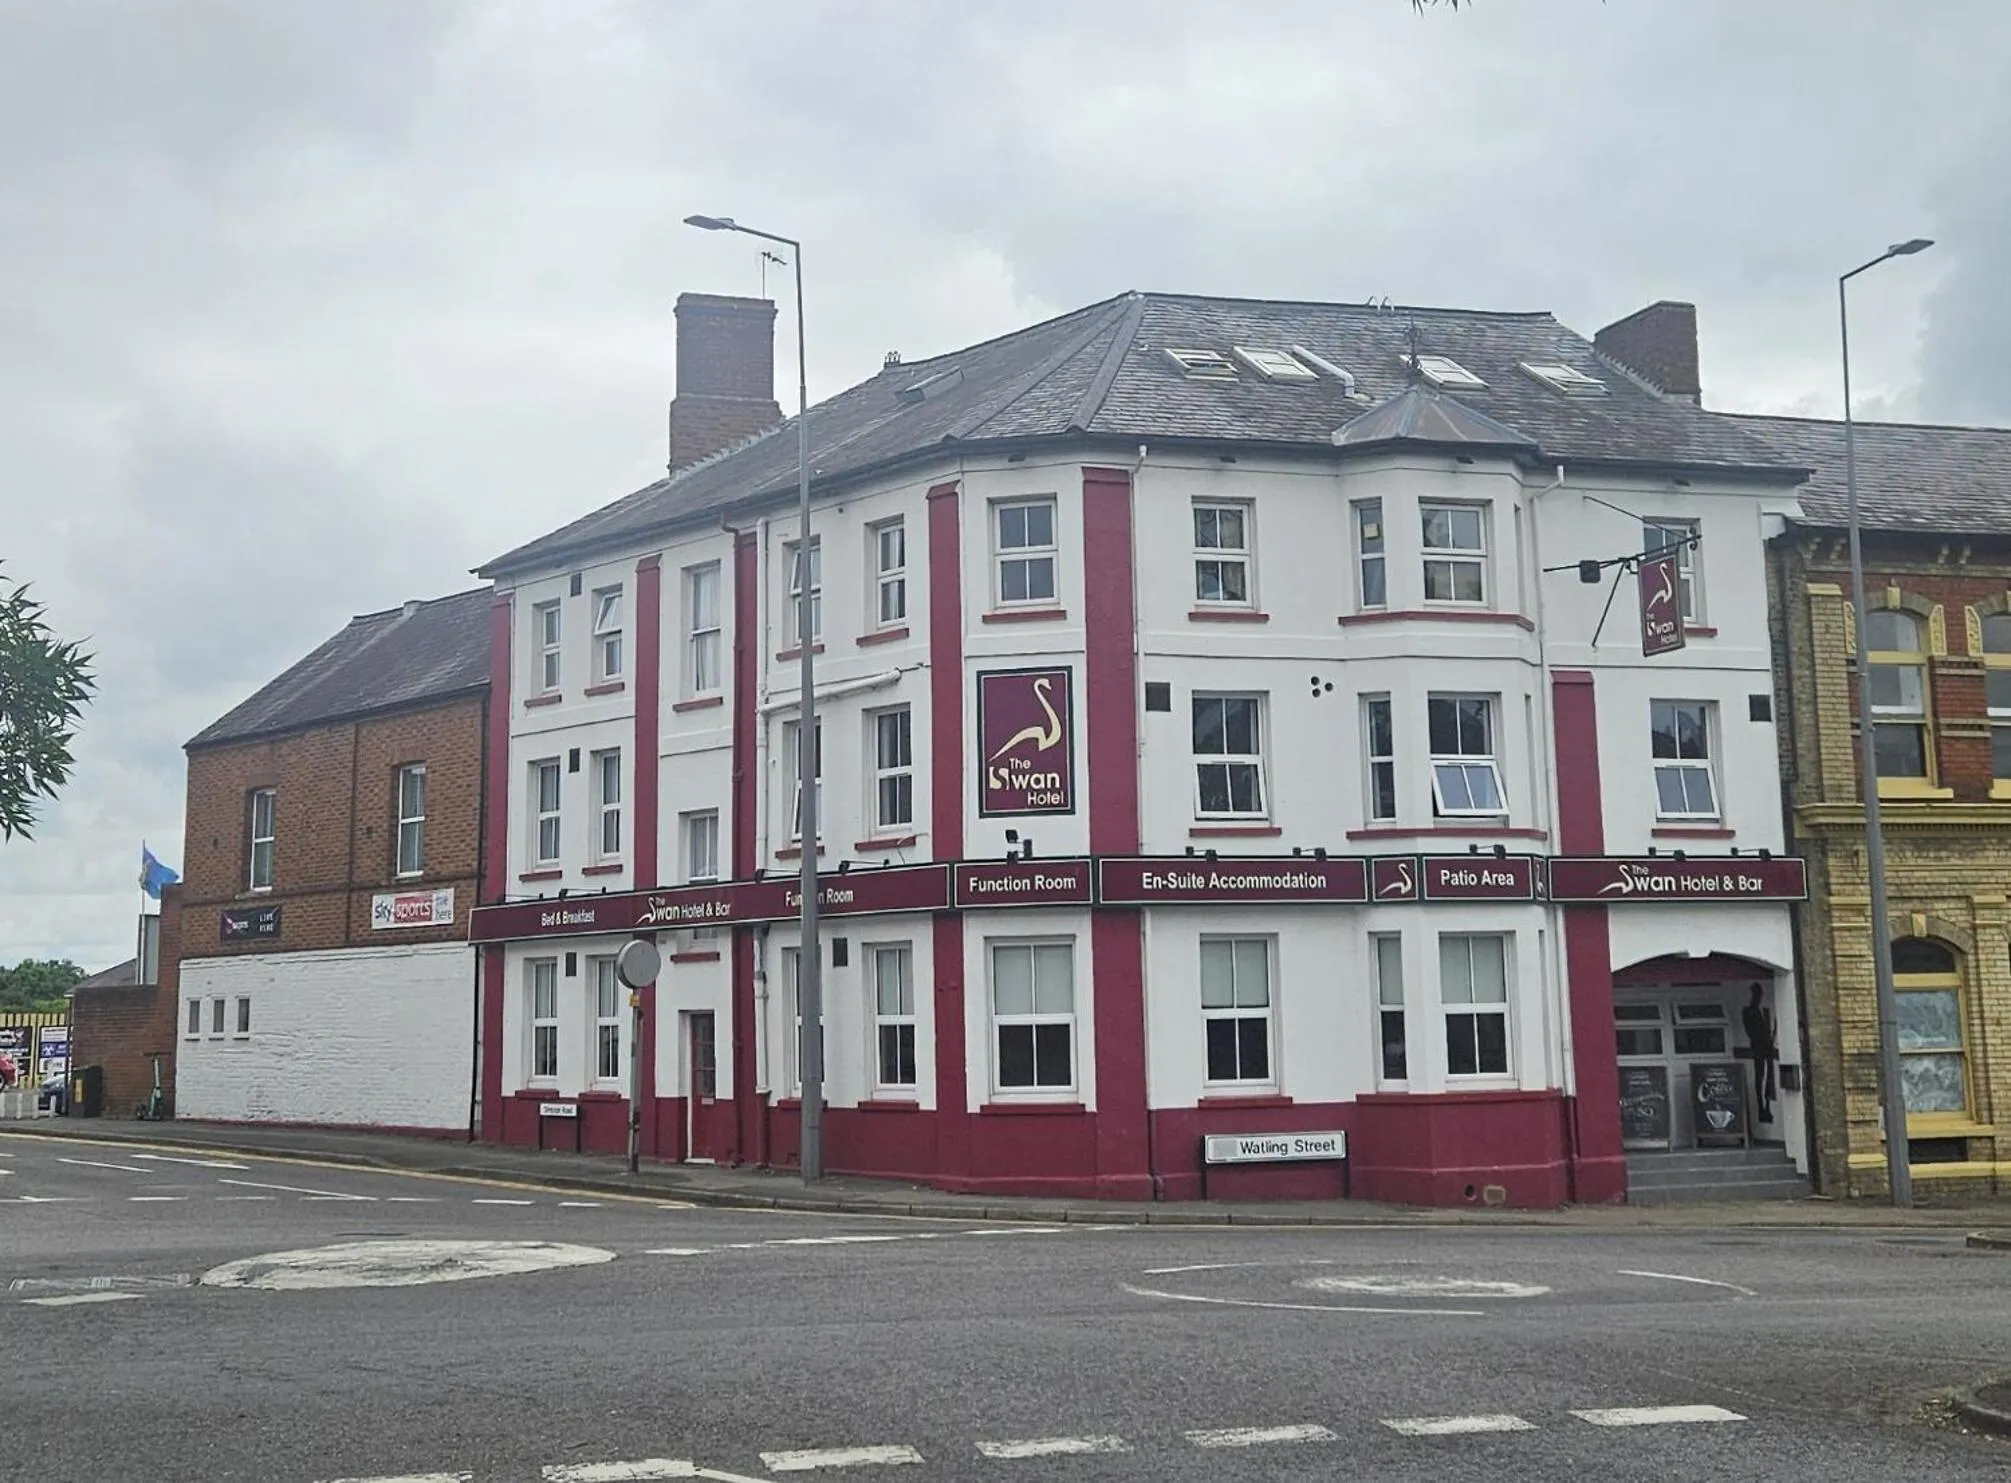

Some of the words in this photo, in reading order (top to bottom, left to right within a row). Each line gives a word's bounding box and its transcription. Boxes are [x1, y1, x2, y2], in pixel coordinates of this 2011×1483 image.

[1647, 621, 1674, 636] Swan
[1009, 758, 1031, 769] The
[989, 766, 1060, 791] Swan
[1027, 791, 1064, 806] Hotel
[1440, 869, 1477, 886] Patio
[1481, 869, 1515, 886] Area
[1608, 864, 1676, 894] Swan
[1680, 875, 1720, 892] Hotel
[1723, 876, 1735, 891] &
[1738, 876, 1764, 892] Bar
[1632, 865, 1648, 875] The
[969, 876, 1031, 893] Function
[1034, 874, 1077, 891] Room
[1142, 871, 1205, 890] En-Suite
[1209, 872, 1327, 890] Accommodation
[785, 890, 825, 907] Funn
[826, 888, 854, 904] Room
[375, 901, 391, 921] sky
[396, 902, 430, 918] sports
[541, 912, 555, 926] Bed
[555, 911, 561, 925] &
[562, 909, 595, 924] Breakfast
[643, 896, 680, 923] Swan
[680, 903, 704, 918] Hotel
[706, 902, 713, 917] &
[715, 901, 731, 917] Bar
[1240, 1140, 1288, 1156] Watling
[1294, 1139, 1336, 1153] Street
